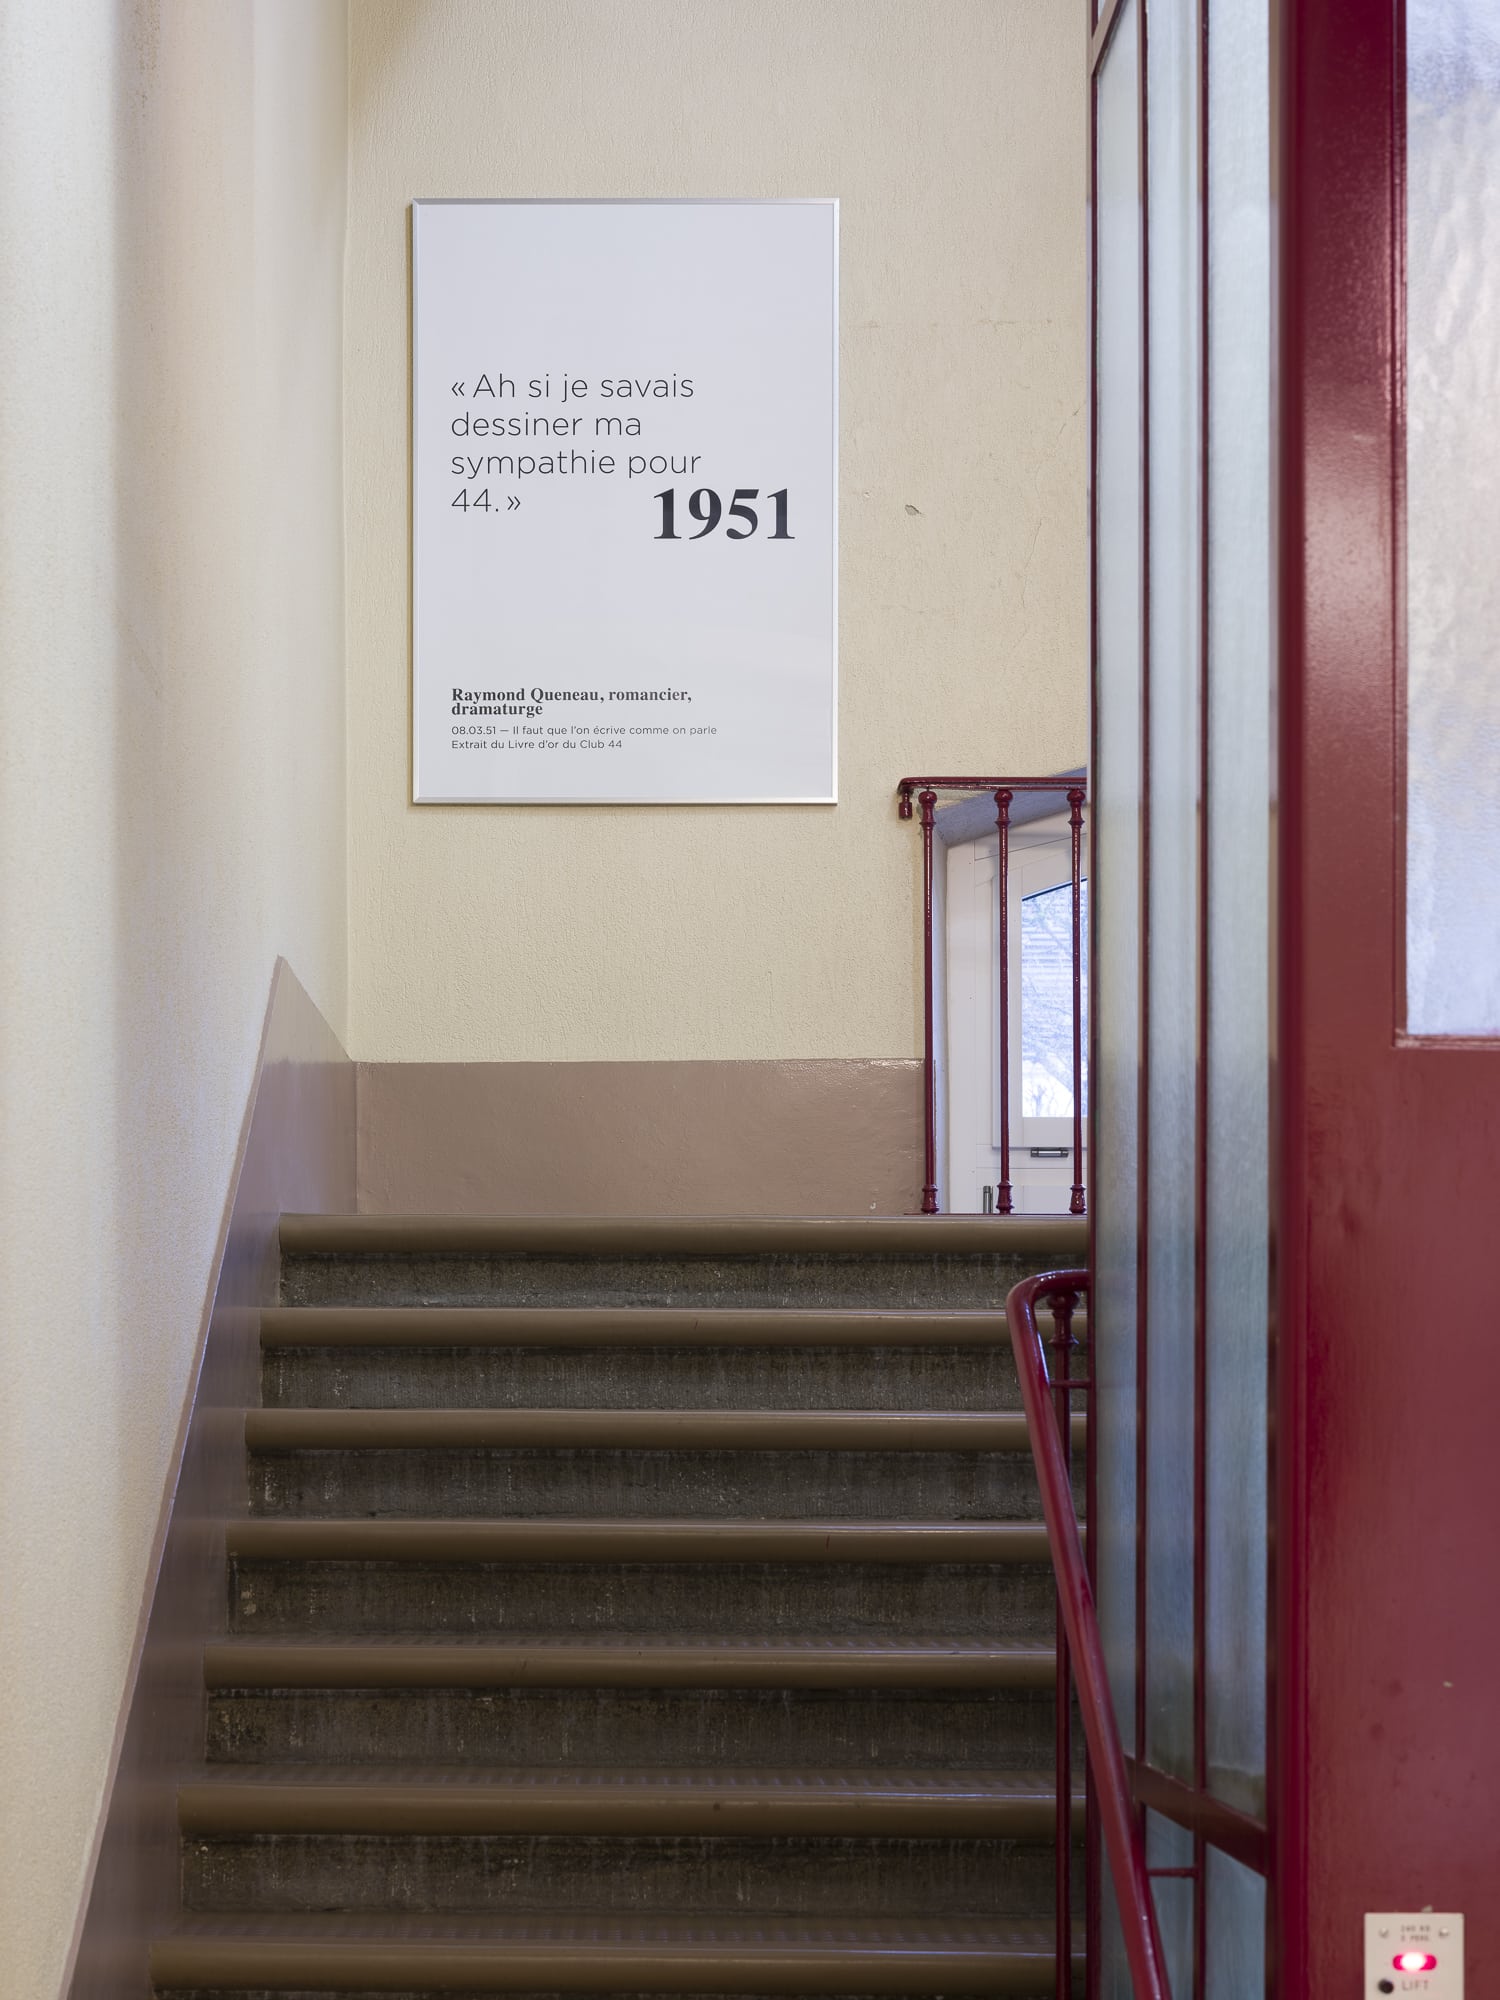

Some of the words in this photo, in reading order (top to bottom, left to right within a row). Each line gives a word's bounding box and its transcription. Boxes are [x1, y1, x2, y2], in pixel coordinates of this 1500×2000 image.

[527, 373, 550, 398] si
[560, 372, 589, 403] je
[600, 372, 694, 398] savais
[451, 410, 584, 437] dessiner
[595, 417, 641, 437] ma
[450, 448, 616, 480] sympathie
[628, 455, 702, 480] pour
[653, 487, 796, 541] 1951
[451, 687, 526, 705] Raymond
[530, 687, 605, 704] Queneau,
[608, 687, 692, 704] romancier,
[451, 702, 544, 719] dramaturge
[451, 725, 496, 736] 08.03.51
[512, 725, 520, 735] Il
[521, 725, 544, 736] faut
[546, 727, 568, 738] que
[592, 725, 626, 736] écrive
[629, 727, 670, 736] comme
[672, 727, 687, 736] on
[689, 725, 718, 738] parle
[451, 739, 488, 750] Extrait
[490, 739, 505, 750] du
[508, 739, 535, 750] Livre
[562, 739, 577, 750] du
[579, 739, 605, 750] Club
[607, 739, 623, 750] 44
[1401, 1980, 1429, 1992] LIFT
